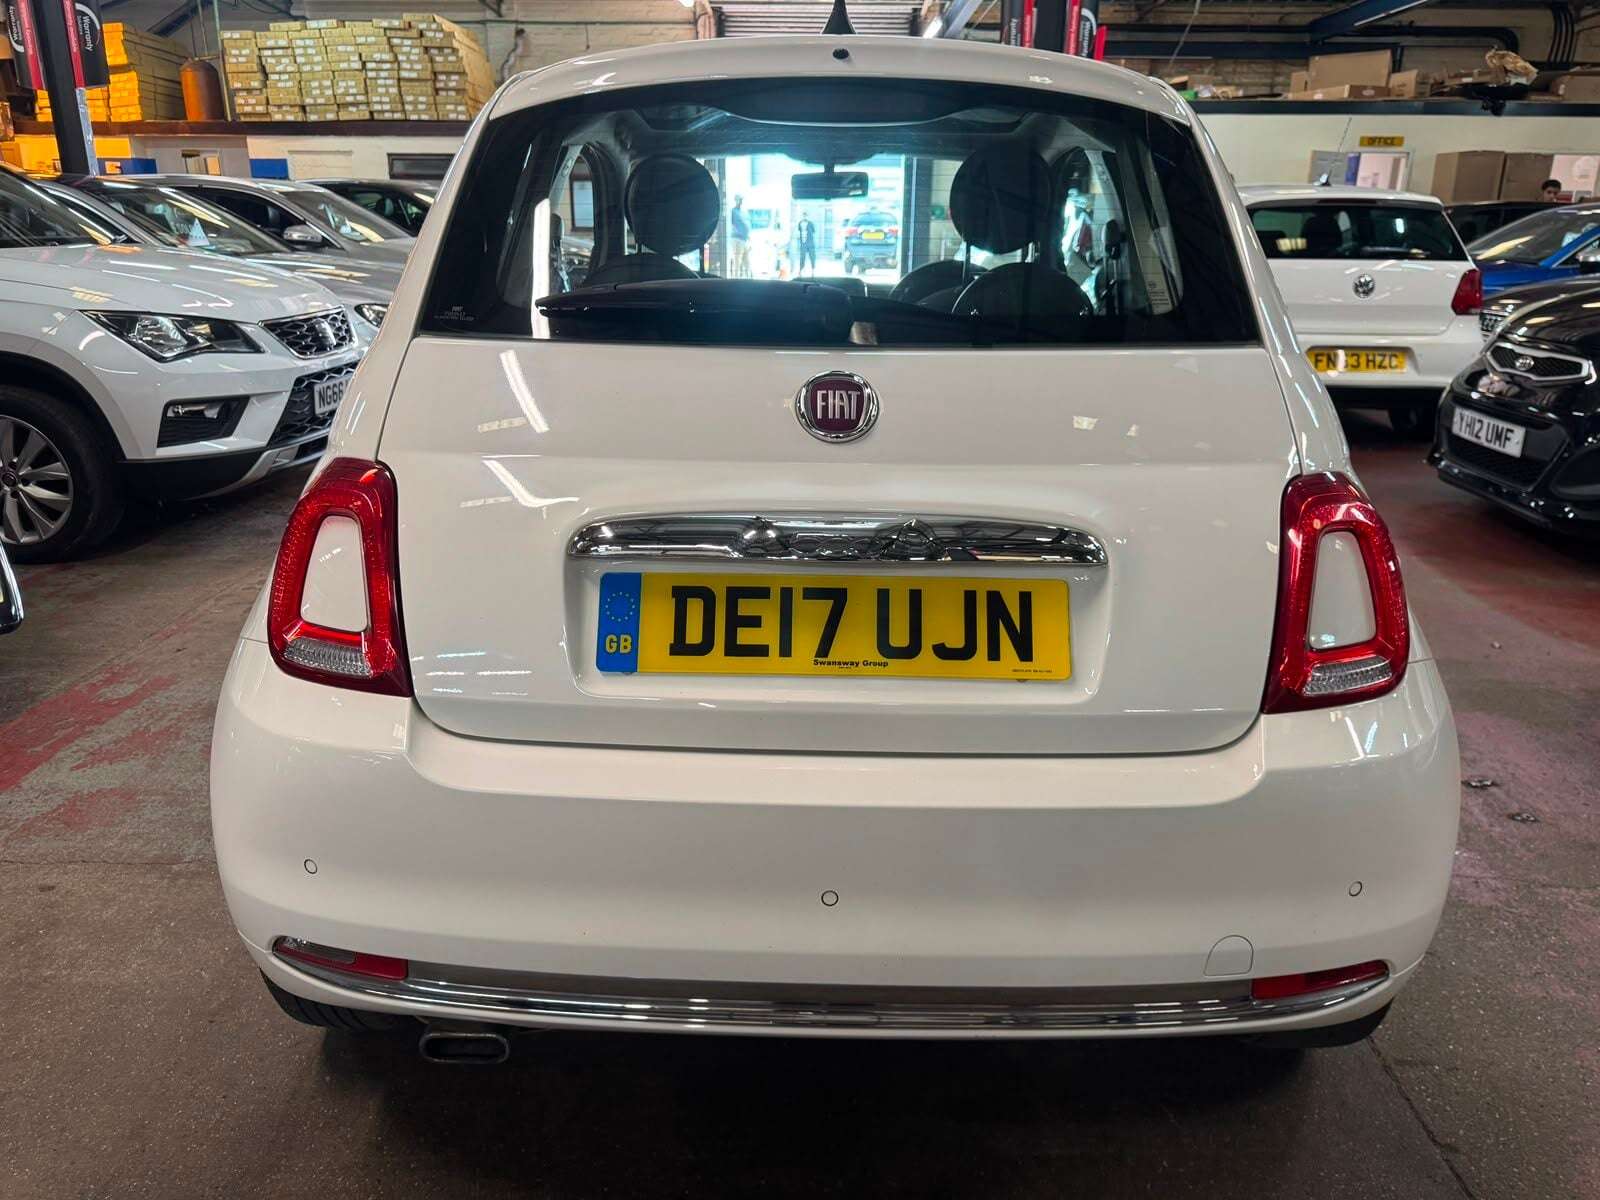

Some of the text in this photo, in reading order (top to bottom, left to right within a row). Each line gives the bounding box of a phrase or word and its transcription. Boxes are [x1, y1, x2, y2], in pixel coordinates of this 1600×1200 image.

[82, 15, 93, 52] Warranty
[1366, 136, 1396, 147] OFFICE
[1314, 352, 1400, 370] FN3 HZC
[816, 390, 861, 420] FIAT
[1459, 413, 1515, 449] YH12 UMF
[669, 585, 1034, 662] DE17 UJN
[605, 634, 632, 654] GB
[813, 659, 860, 668] Swansway
[862, 660, 889, 668] Group
